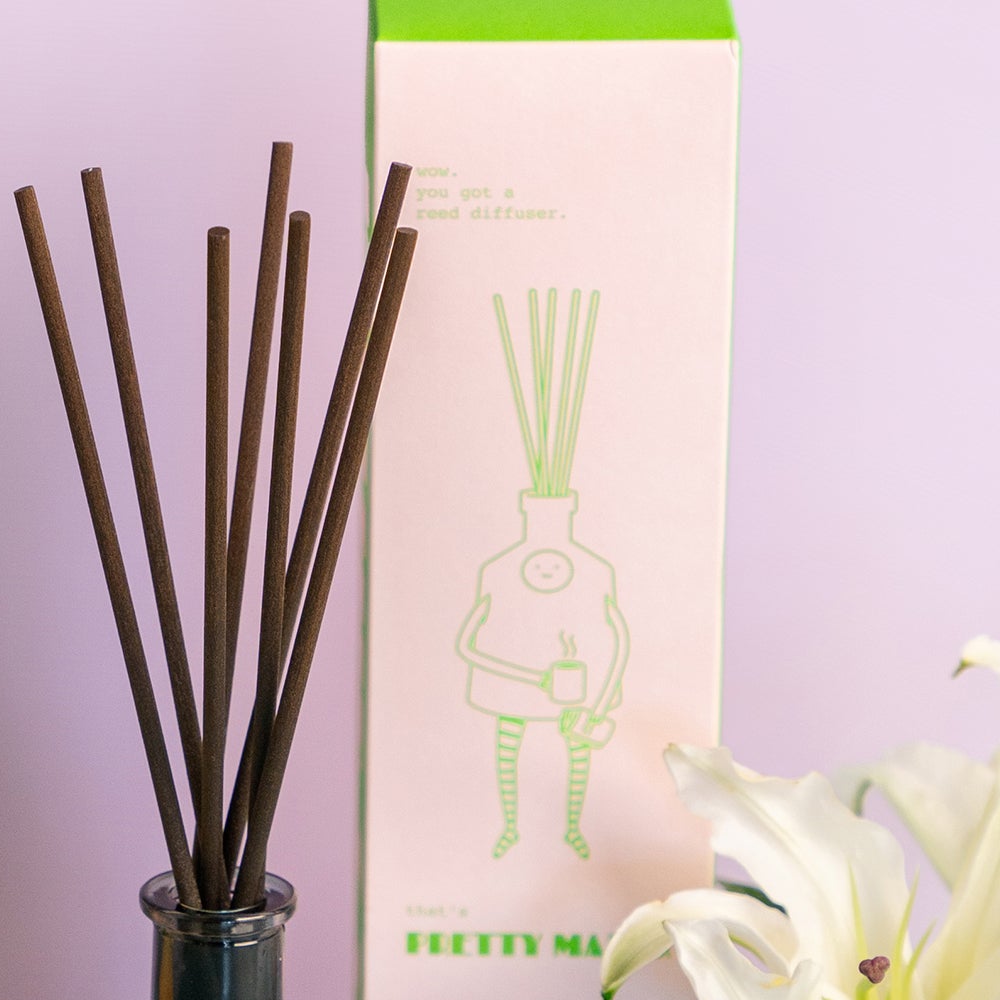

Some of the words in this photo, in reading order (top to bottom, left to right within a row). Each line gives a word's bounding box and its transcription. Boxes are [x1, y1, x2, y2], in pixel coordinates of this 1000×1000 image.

[415, 166, 458, 177] wow.
[415, 186, 449, 202] you
[459, 186, 492, 202] got
[504, 187, 515, 199] a
[415, 205, 460, 220] reed
[470, 205, 567, 220] diffuser.
[405, 931, 543, 957] PRETTY
